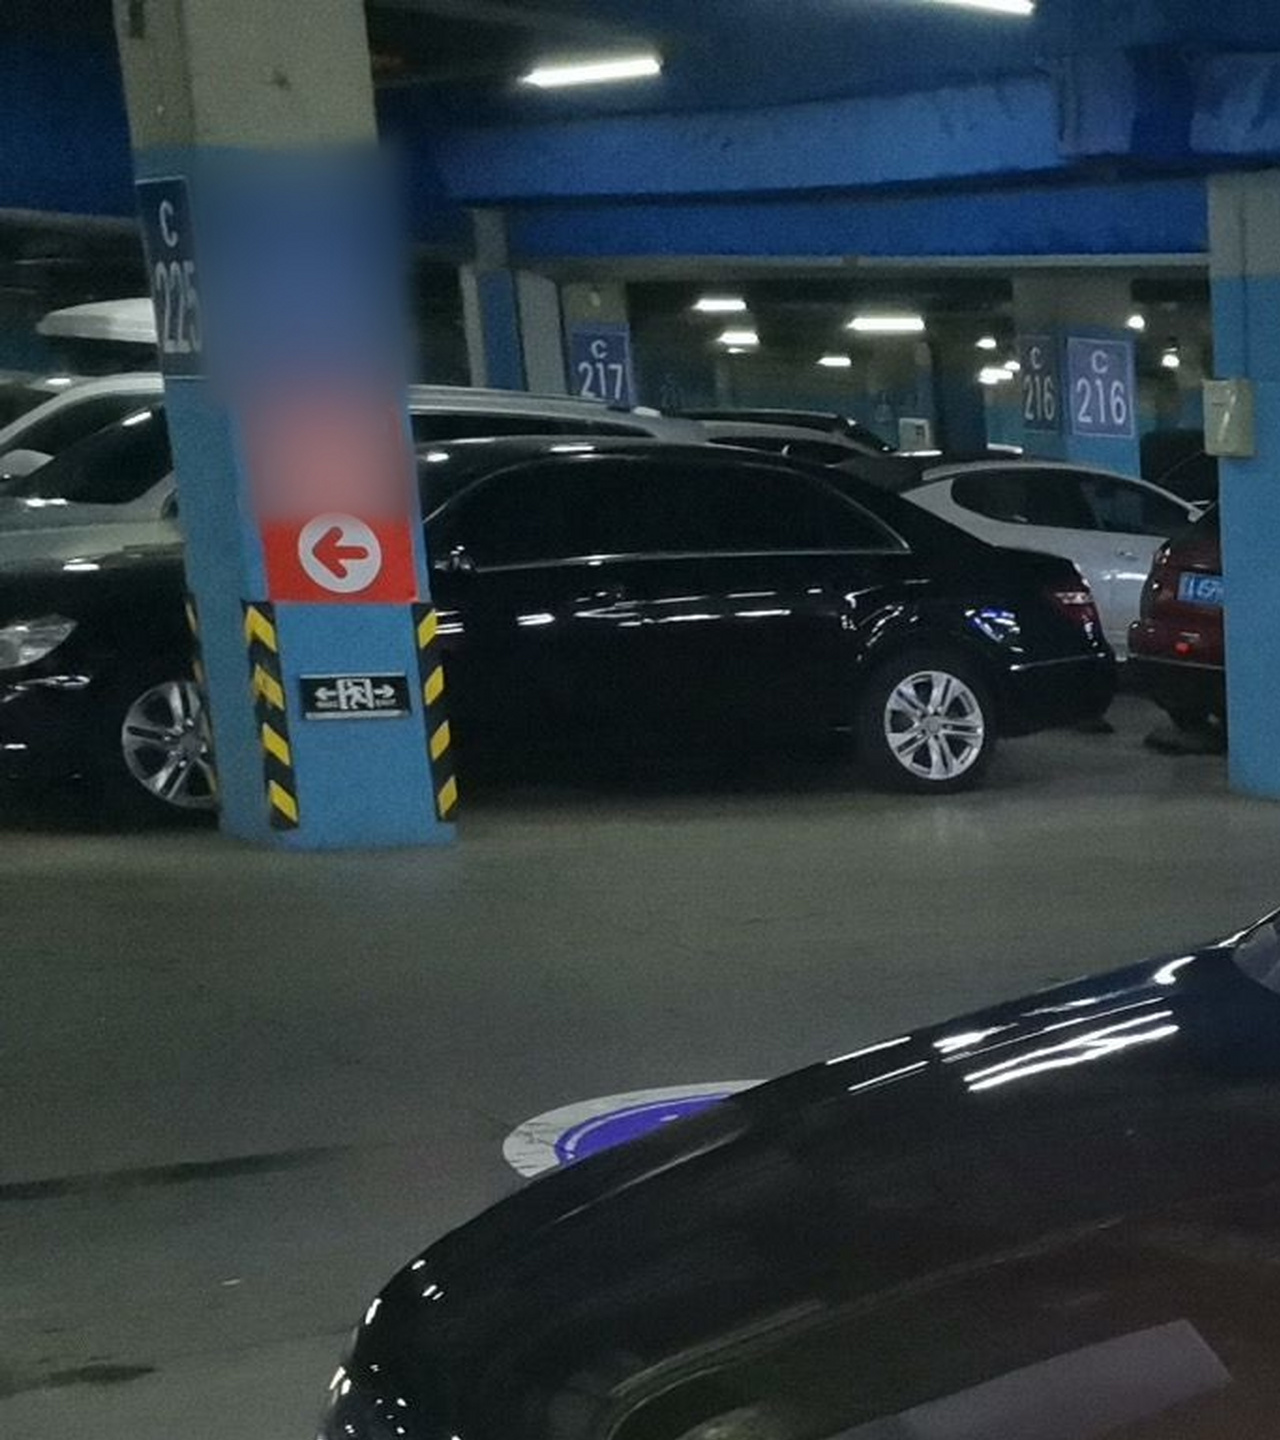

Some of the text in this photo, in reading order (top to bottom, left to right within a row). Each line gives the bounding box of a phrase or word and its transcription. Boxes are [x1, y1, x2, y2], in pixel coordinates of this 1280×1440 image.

[159, 200, 178, 247] C
[591, 340, 607, 359] C
[1030, 346, 1042, 369] C
[1091, 350, 1108, 373] C
[578, 361, 622, 399] 217
[1023, 375, 1055, 420] 216
[1077, 377, 1126, 424] 216
